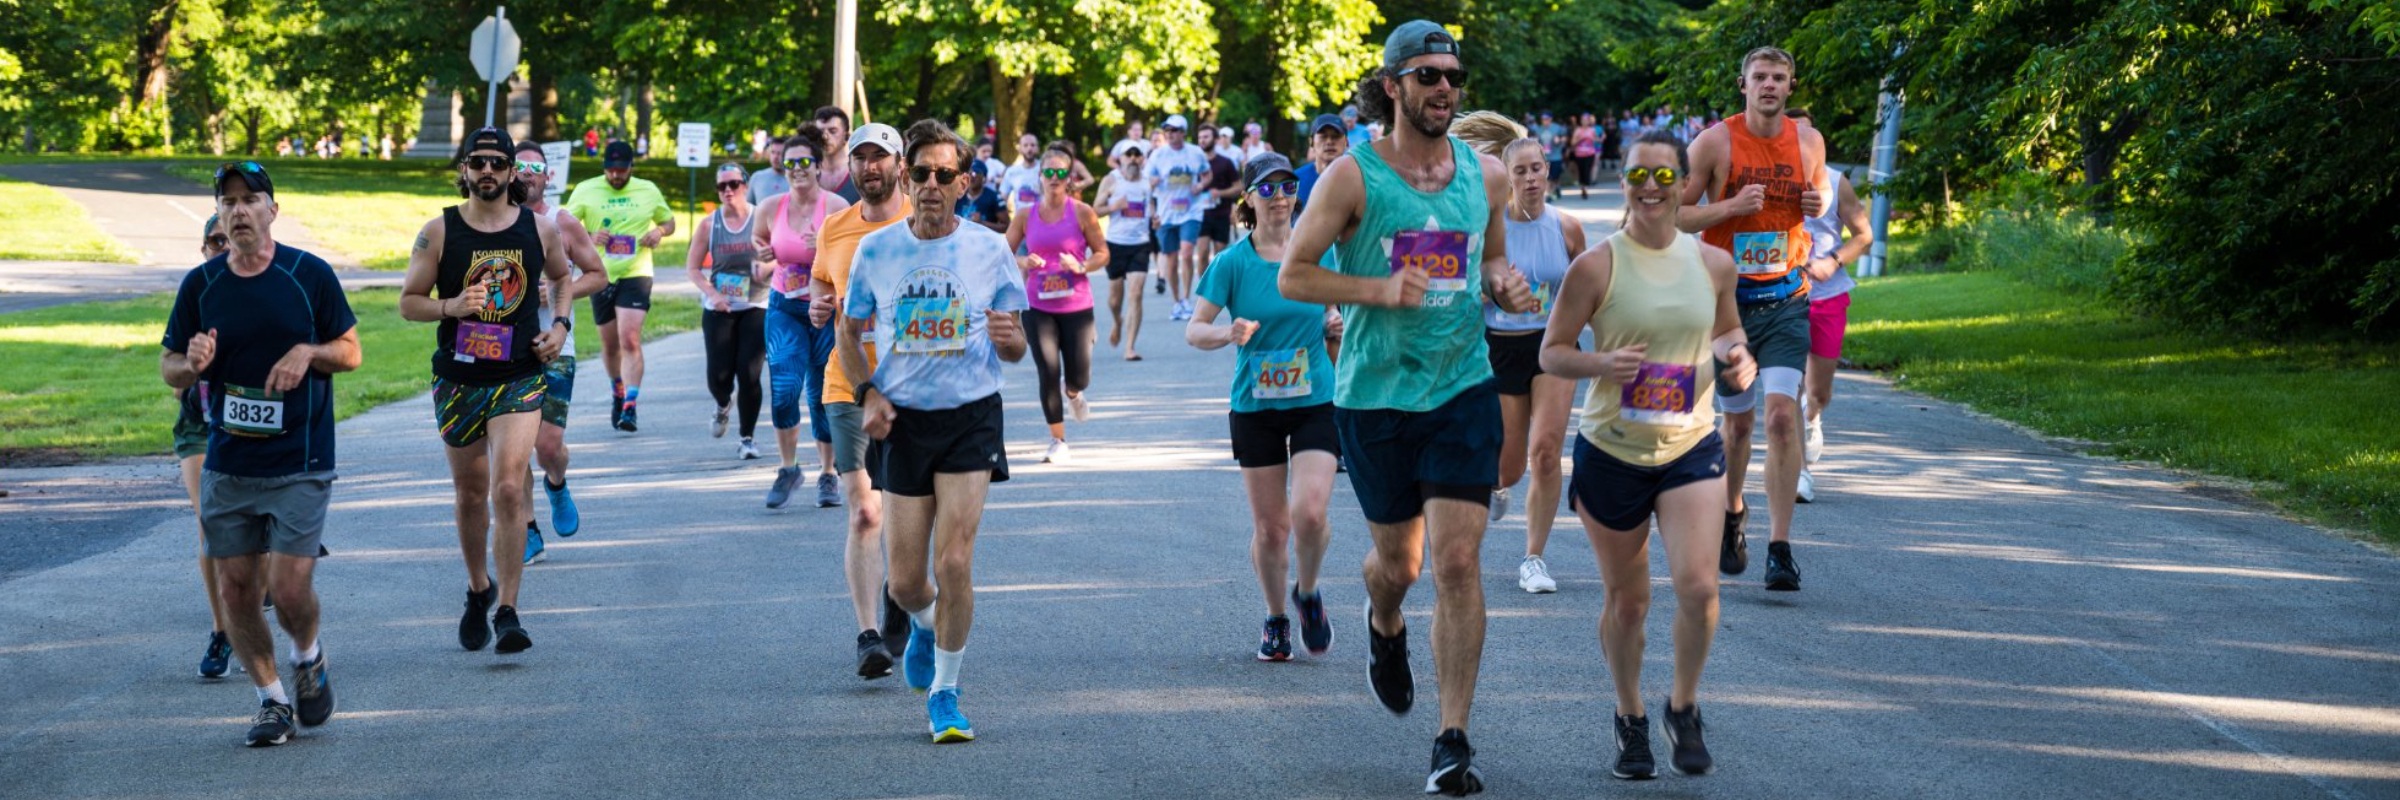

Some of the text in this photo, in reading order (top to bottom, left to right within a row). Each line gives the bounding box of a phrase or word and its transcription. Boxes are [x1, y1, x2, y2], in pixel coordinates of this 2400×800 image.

[1741, 248, 1781, 265] 402
[904, 318, 956, 340] 436
[463, 338, 503, 358] 786
[1258, 367, 1302, 387] 407
[1633, 385, 1686, 412] 839
[228, 400, 276, 425] 3832
